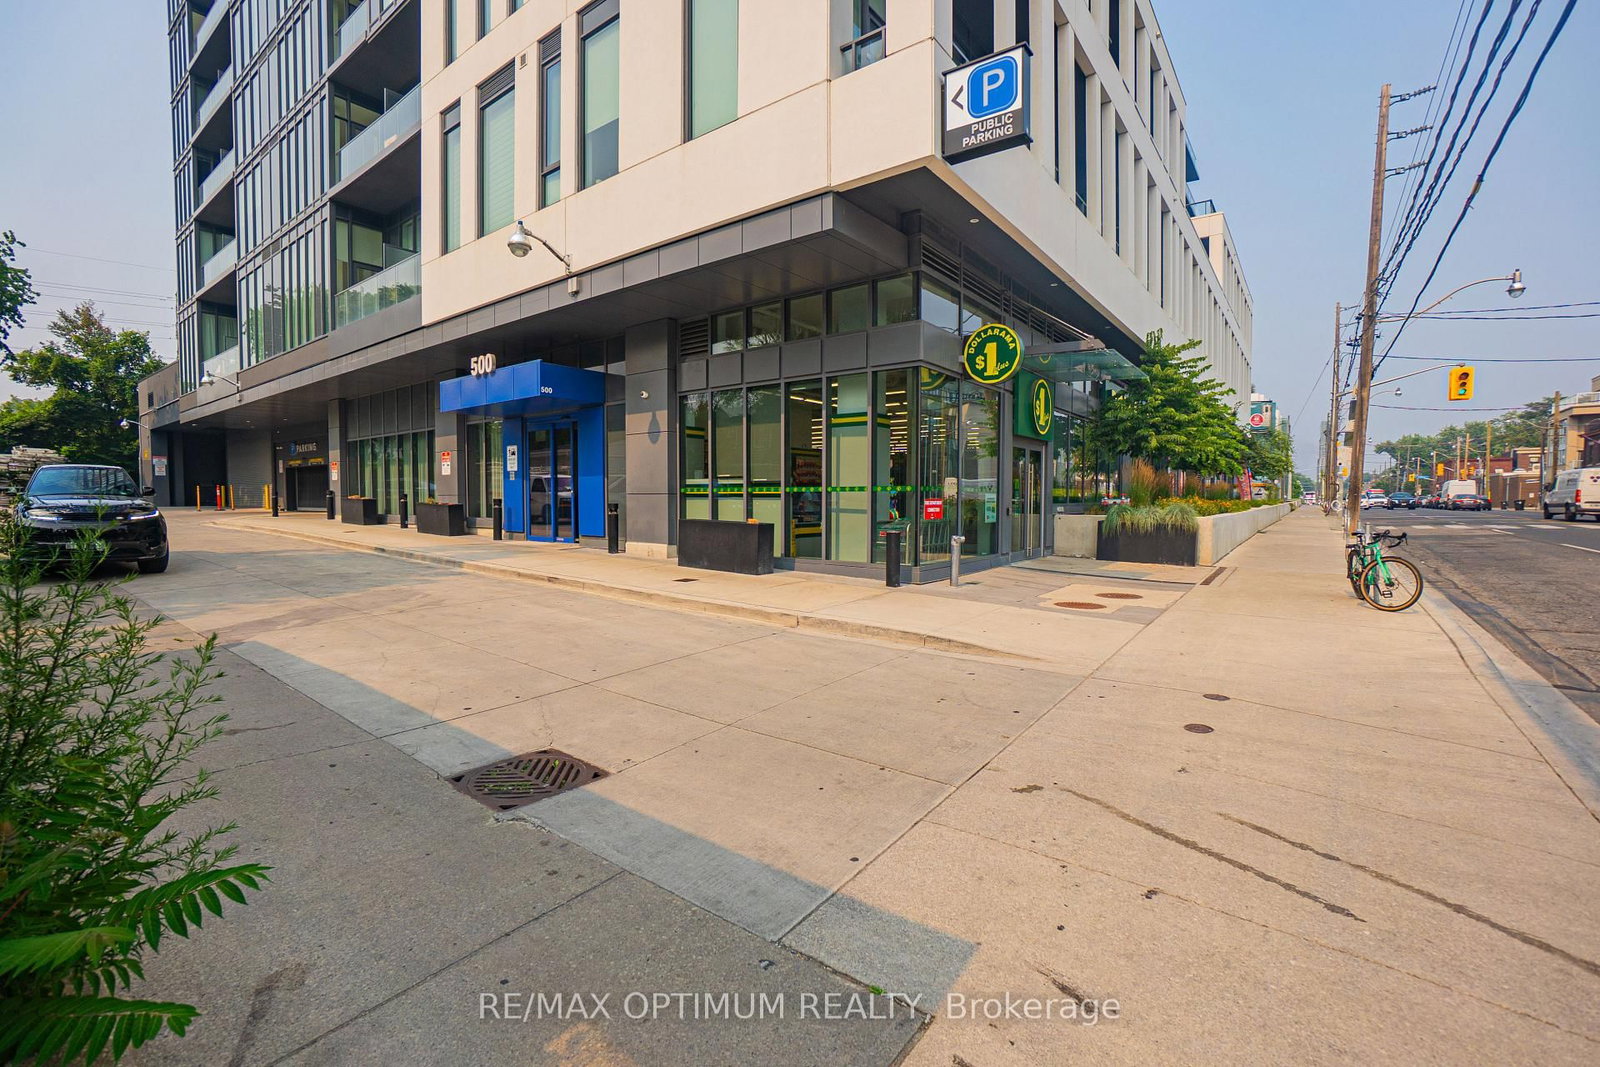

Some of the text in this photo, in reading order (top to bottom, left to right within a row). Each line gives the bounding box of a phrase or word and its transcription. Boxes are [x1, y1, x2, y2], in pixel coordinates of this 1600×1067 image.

[982, 68, 1005, 107] P
[971, 113, 1014, 134] PUBLIC
[962, 124, 1014, 148] PARKING
[968, 328, 1016, 354] DOLLARAMA
[470, 353, 495, 376] 500
[540, 386, 553, 394] 500
[296, 442, 317, 453] PARKING
